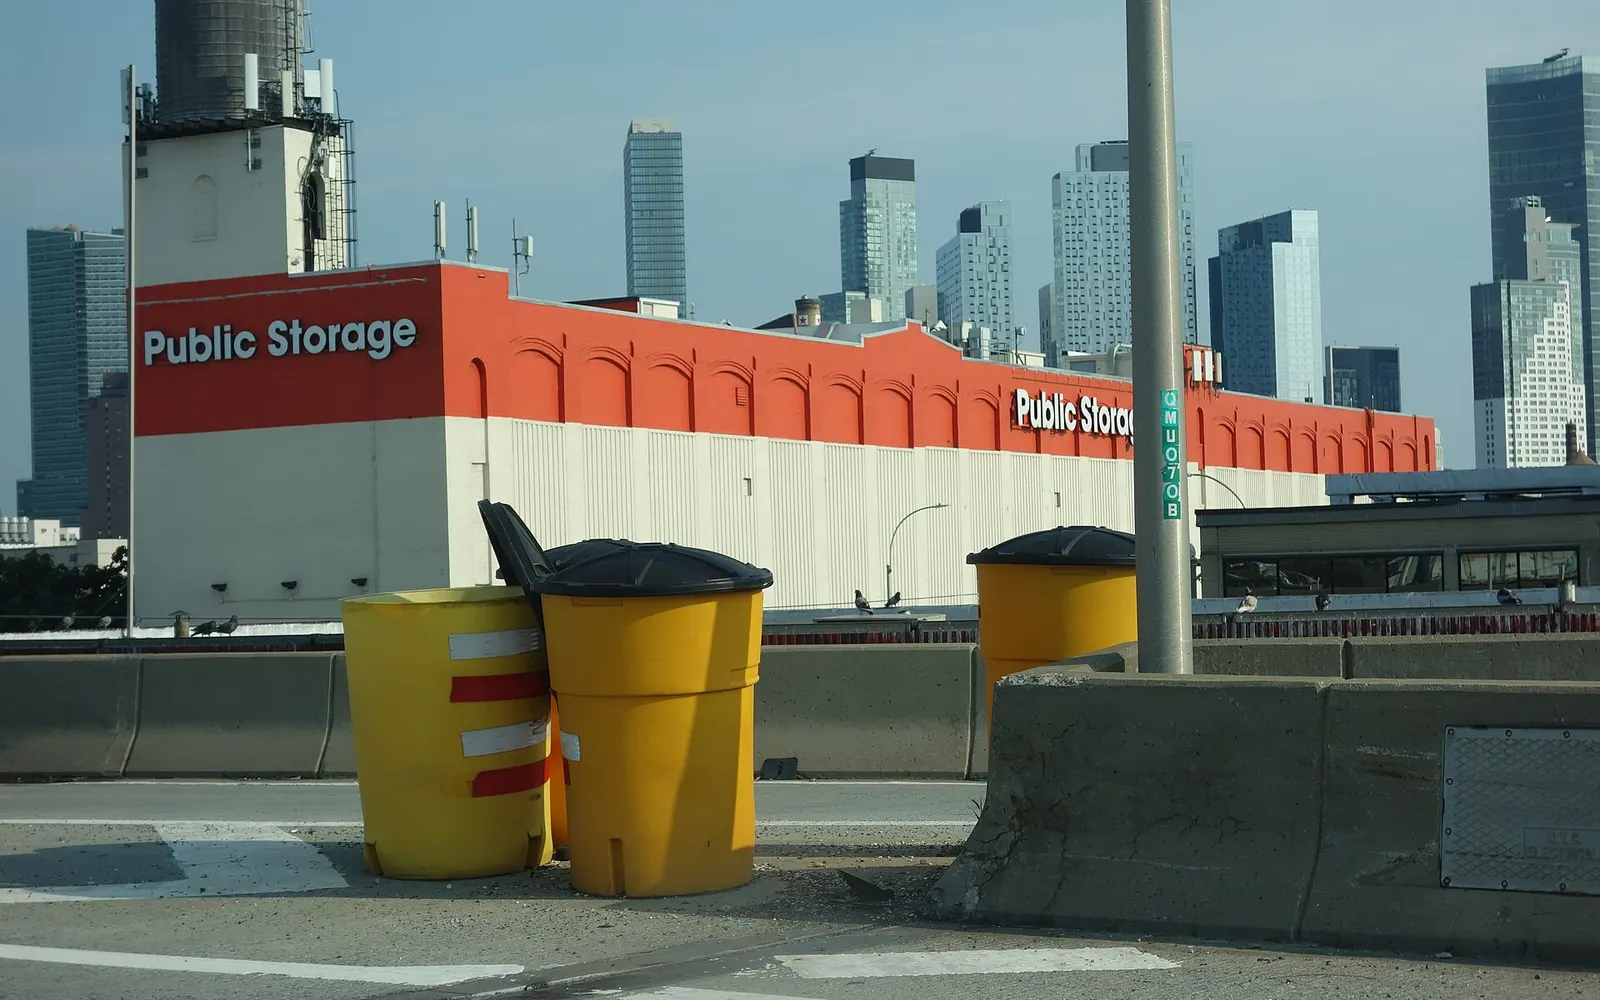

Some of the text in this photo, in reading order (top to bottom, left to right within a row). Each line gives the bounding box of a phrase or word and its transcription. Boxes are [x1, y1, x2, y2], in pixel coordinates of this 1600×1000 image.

[144, 317, 417, 366] Public Storage
[1015, 388, 1077, 431] Public
